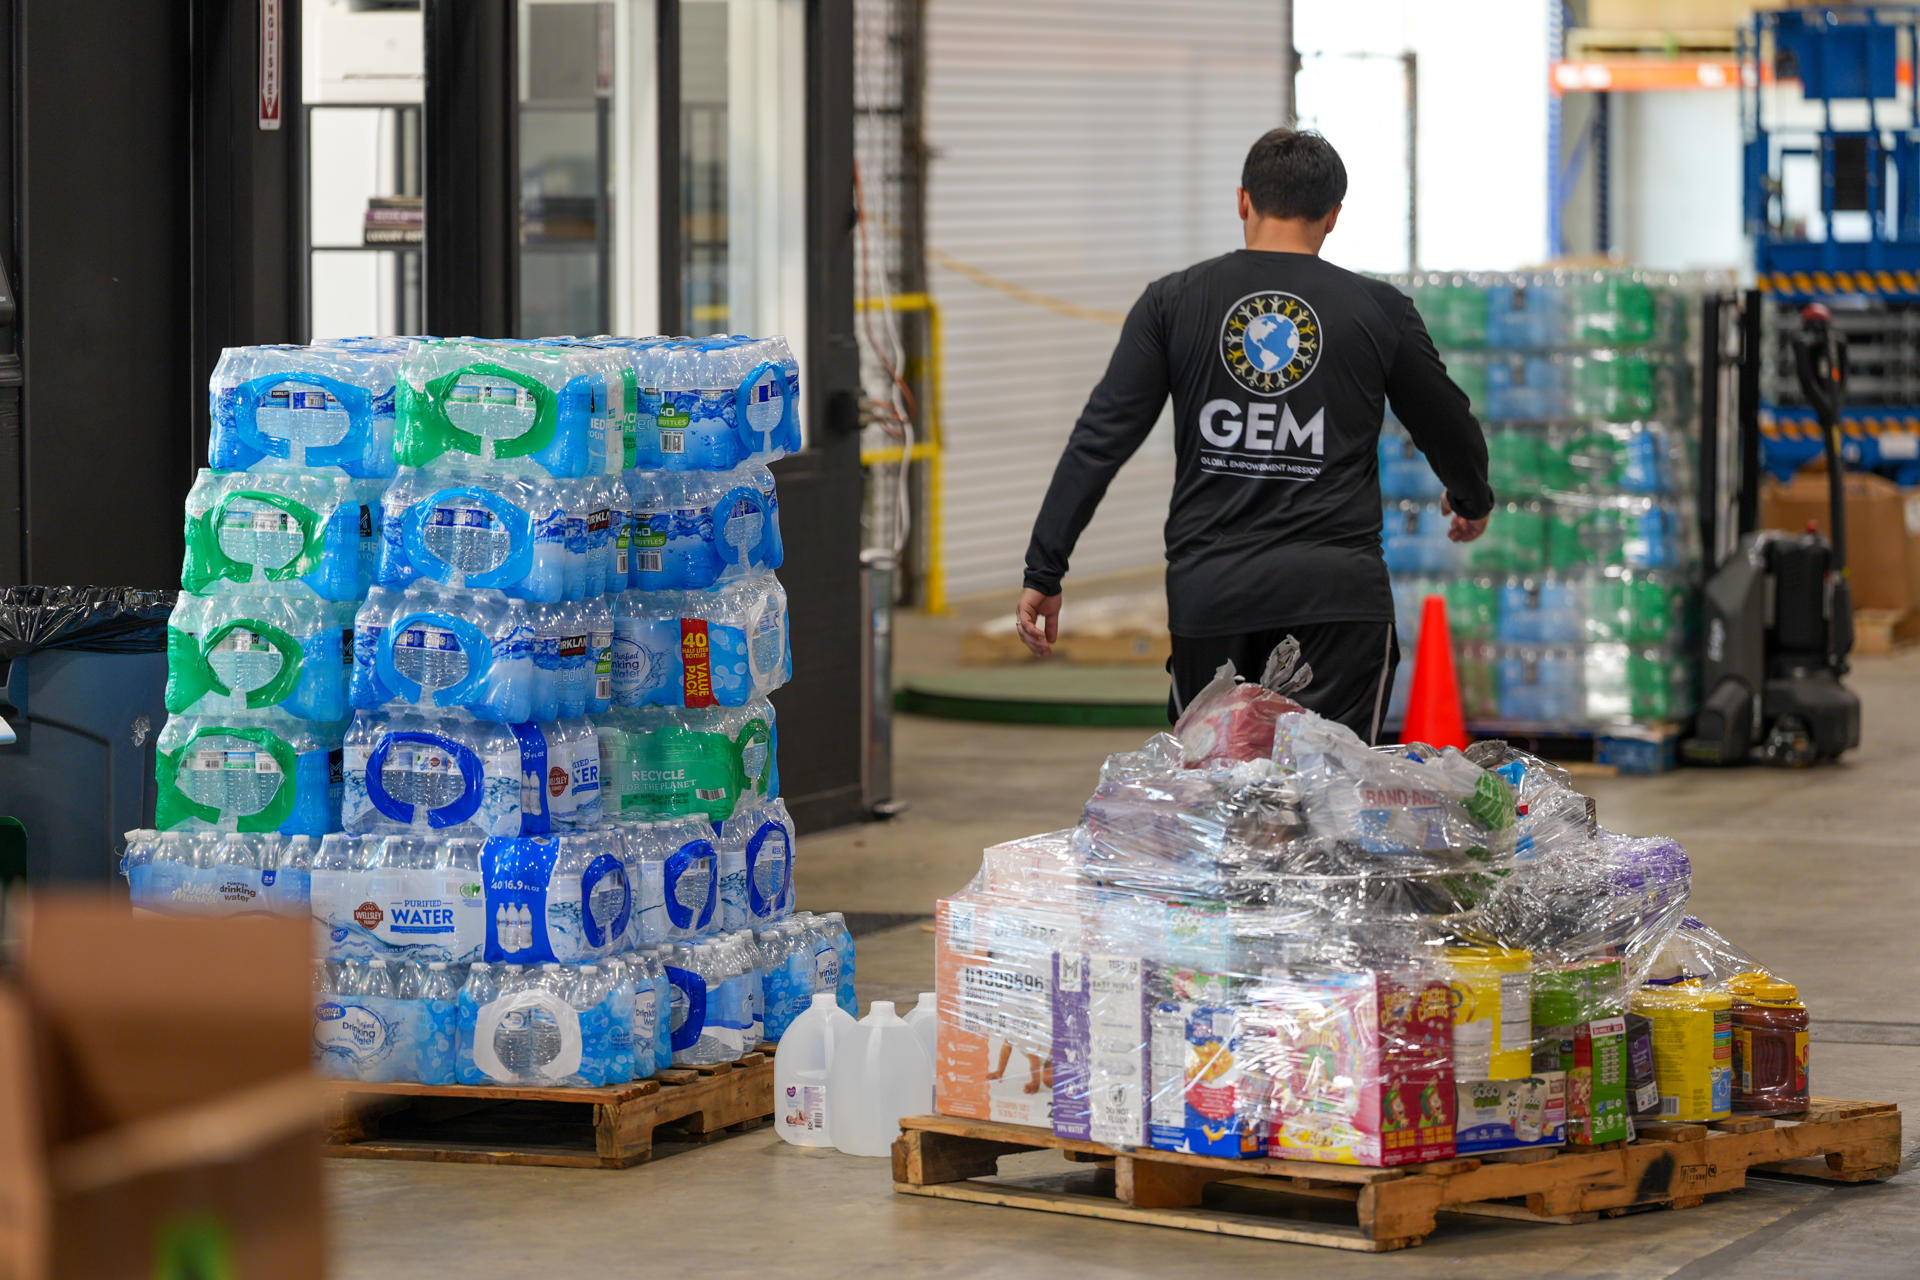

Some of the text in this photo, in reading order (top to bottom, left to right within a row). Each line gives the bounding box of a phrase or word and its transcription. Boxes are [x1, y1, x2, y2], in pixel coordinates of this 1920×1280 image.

[660, 407, 675, 416] 40
[1199, 399, 1324, 455] GEM
[1200, 457, 1228, 468] GLOBAL
[1287, 464, 1321, 475] MISSION
[635, 527, 651, 537] 40
[683, 632, 707, 648] 40
[685, 665, 698, 696] PACK
[696, 662, 710, 696] VALUE
[631, 768, 686, 782] RECYCLE
[642, 782, 661, 791] THE
[660, 779, 697, 790] PLANET
[219, 885, 256, 898] drinking
[504, 880, 524, 890] 16.9
[223, 893, 251, 903] water
[404, 899, 442, 908] PURIFIED
[390, 908, 454, 925] WATER
[342, 1021, 376, 1038] Drinking
